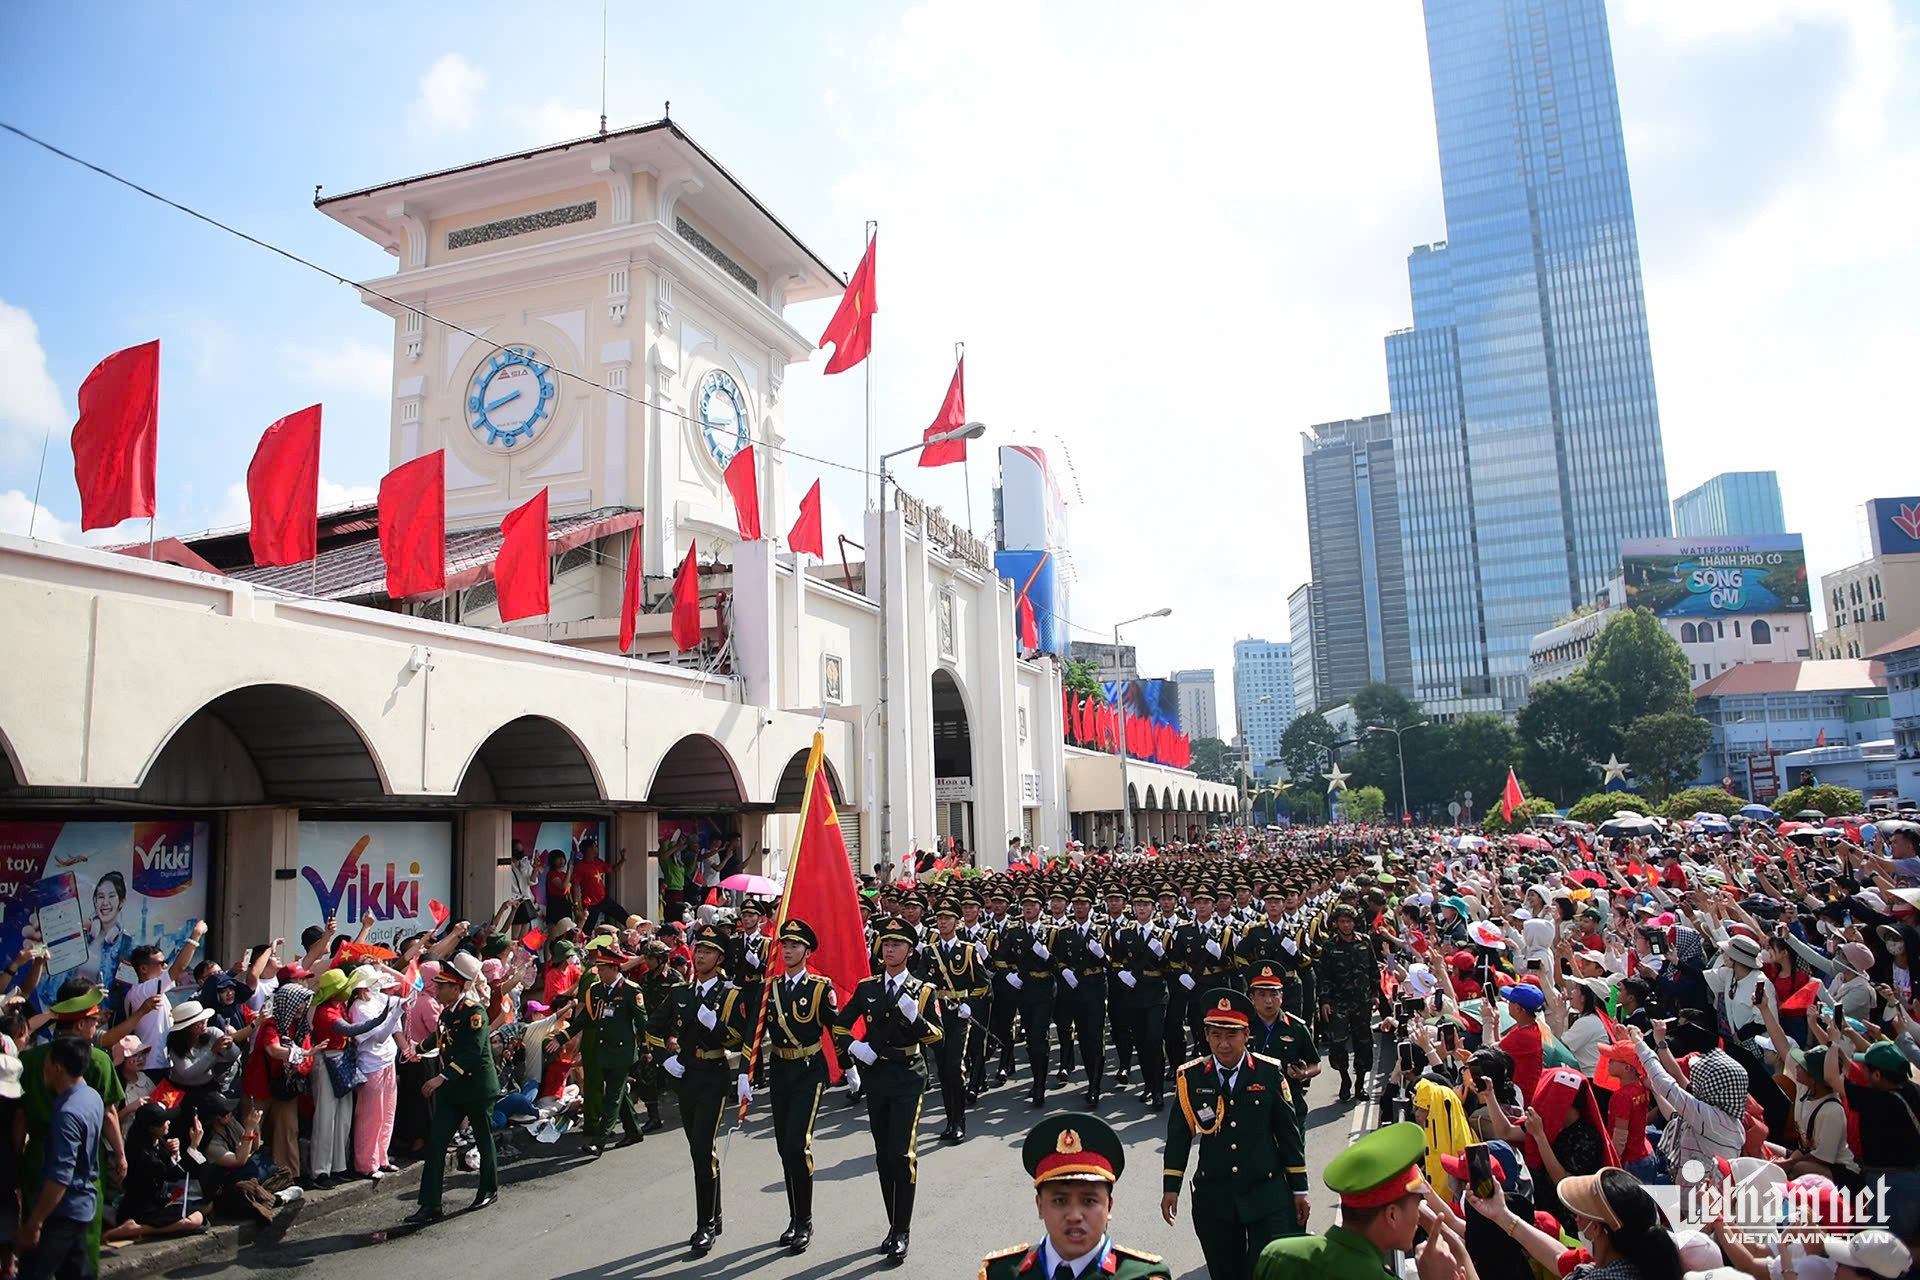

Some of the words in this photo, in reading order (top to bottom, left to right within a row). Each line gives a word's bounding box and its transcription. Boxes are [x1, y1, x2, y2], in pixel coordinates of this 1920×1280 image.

[468, 396, 481, 413] 9
[1680, 545, 1751, 555] WATERPOINT
[1692, 567, 1743, 588] SÔNG
[1710, 588, 1739, 608] ÔM
[135, 834, 190, 870] Vikki
[7, 857, 38, 873] tay,
[301, 835, 420, 923] Vikki
